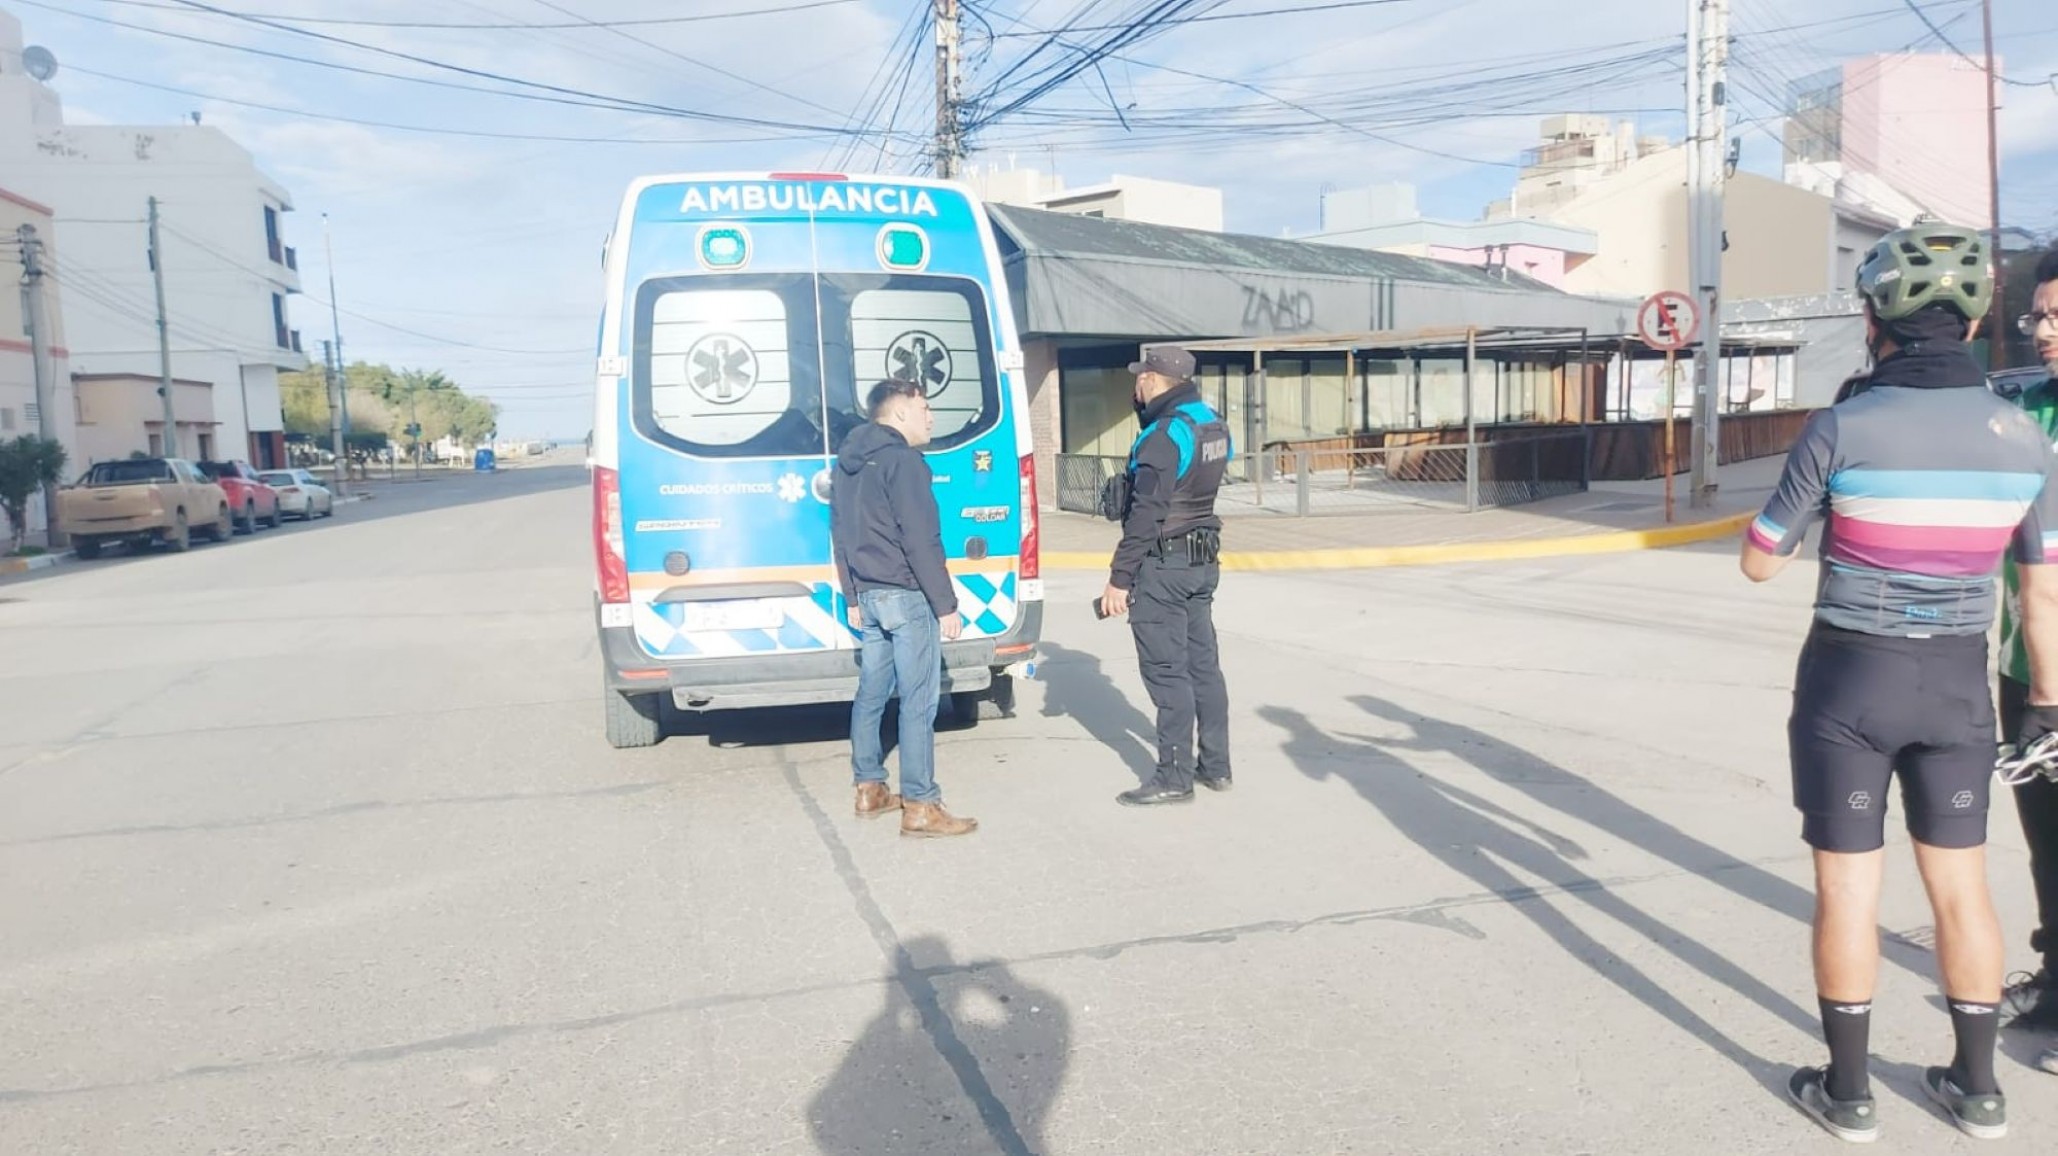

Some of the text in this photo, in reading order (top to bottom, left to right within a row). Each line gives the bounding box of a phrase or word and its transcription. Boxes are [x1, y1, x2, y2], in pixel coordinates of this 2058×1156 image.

[680, 185, 938, 216] AMBULANCIA
[1657, 304, 1678, 337] E
[660, 484, 719, 495] CUIDADOS
